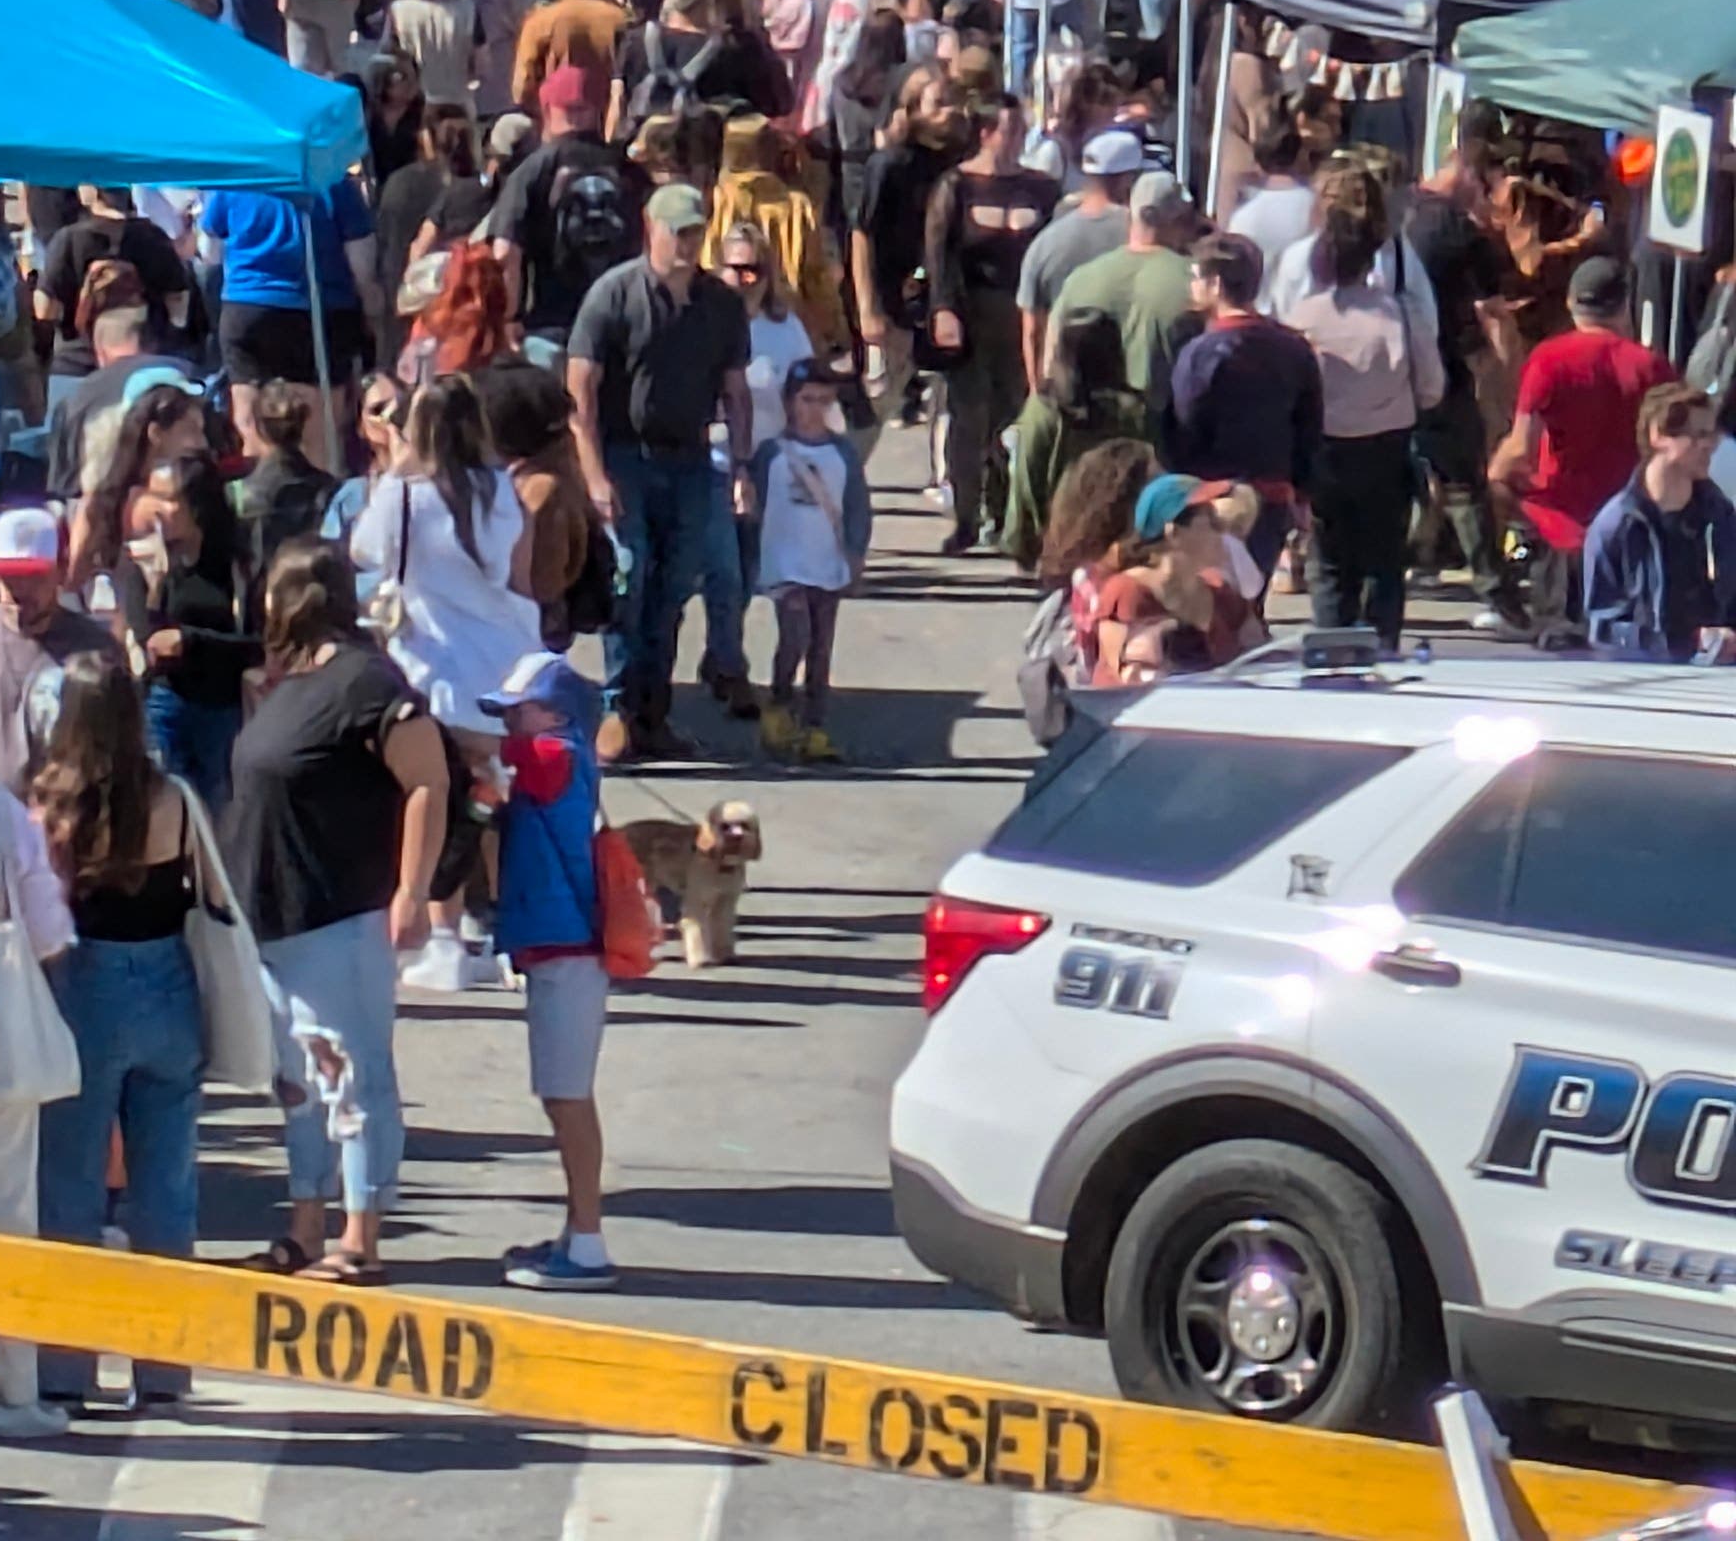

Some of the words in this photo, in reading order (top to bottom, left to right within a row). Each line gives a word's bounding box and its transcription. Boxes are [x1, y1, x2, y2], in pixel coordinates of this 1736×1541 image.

[1053, 945, 1187, 1021] 911
[255, 1291, 494, 1399] ROAD
[731, 1361, 1101, 1494] CLOSED
